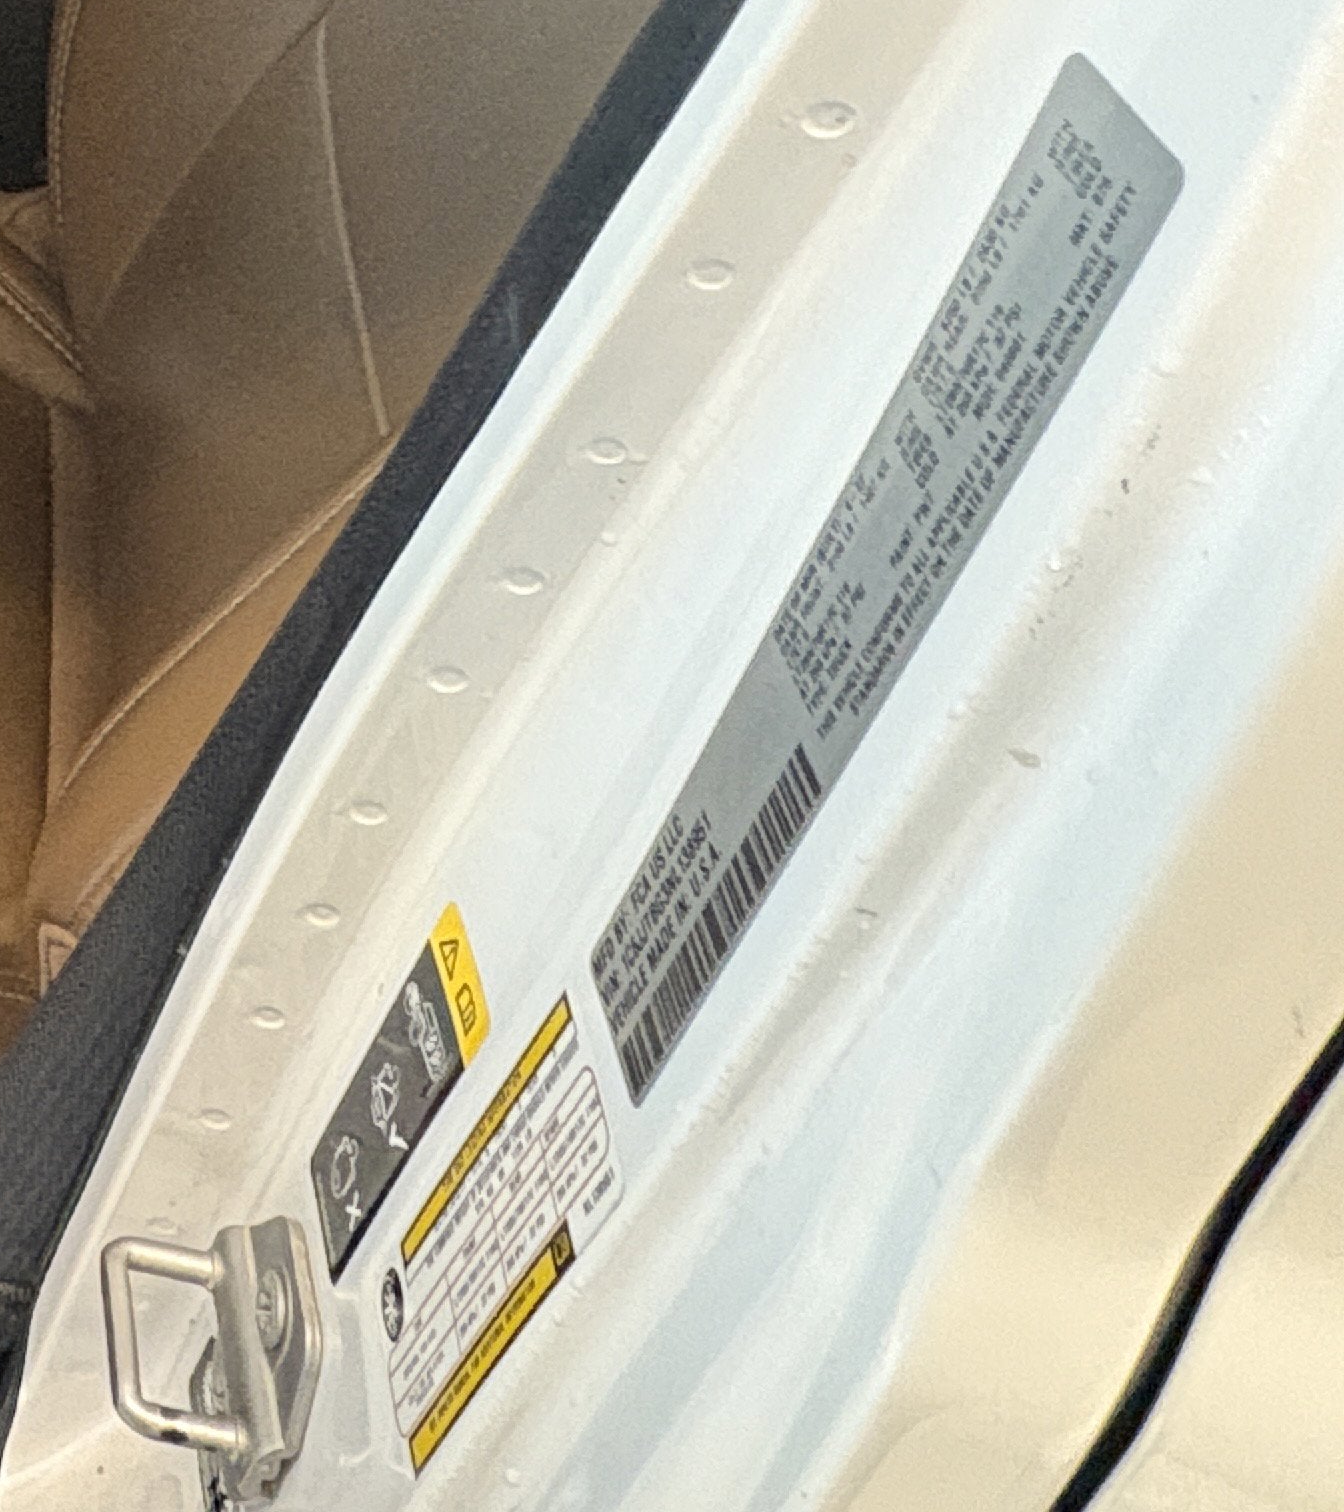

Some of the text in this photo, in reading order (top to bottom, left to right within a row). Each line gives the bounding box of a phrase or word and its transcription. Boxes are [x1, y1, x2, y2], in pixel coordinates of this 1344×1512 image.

[591, 931, 616, 985] MFD
[629, 869, 652, 916] FCA
[647, 842, 667, 884] US
[661, 809, 685, 858] LLC
[607, 957, 649, 1041] VEHICLE
[645, 911, 677, 976] MADE
